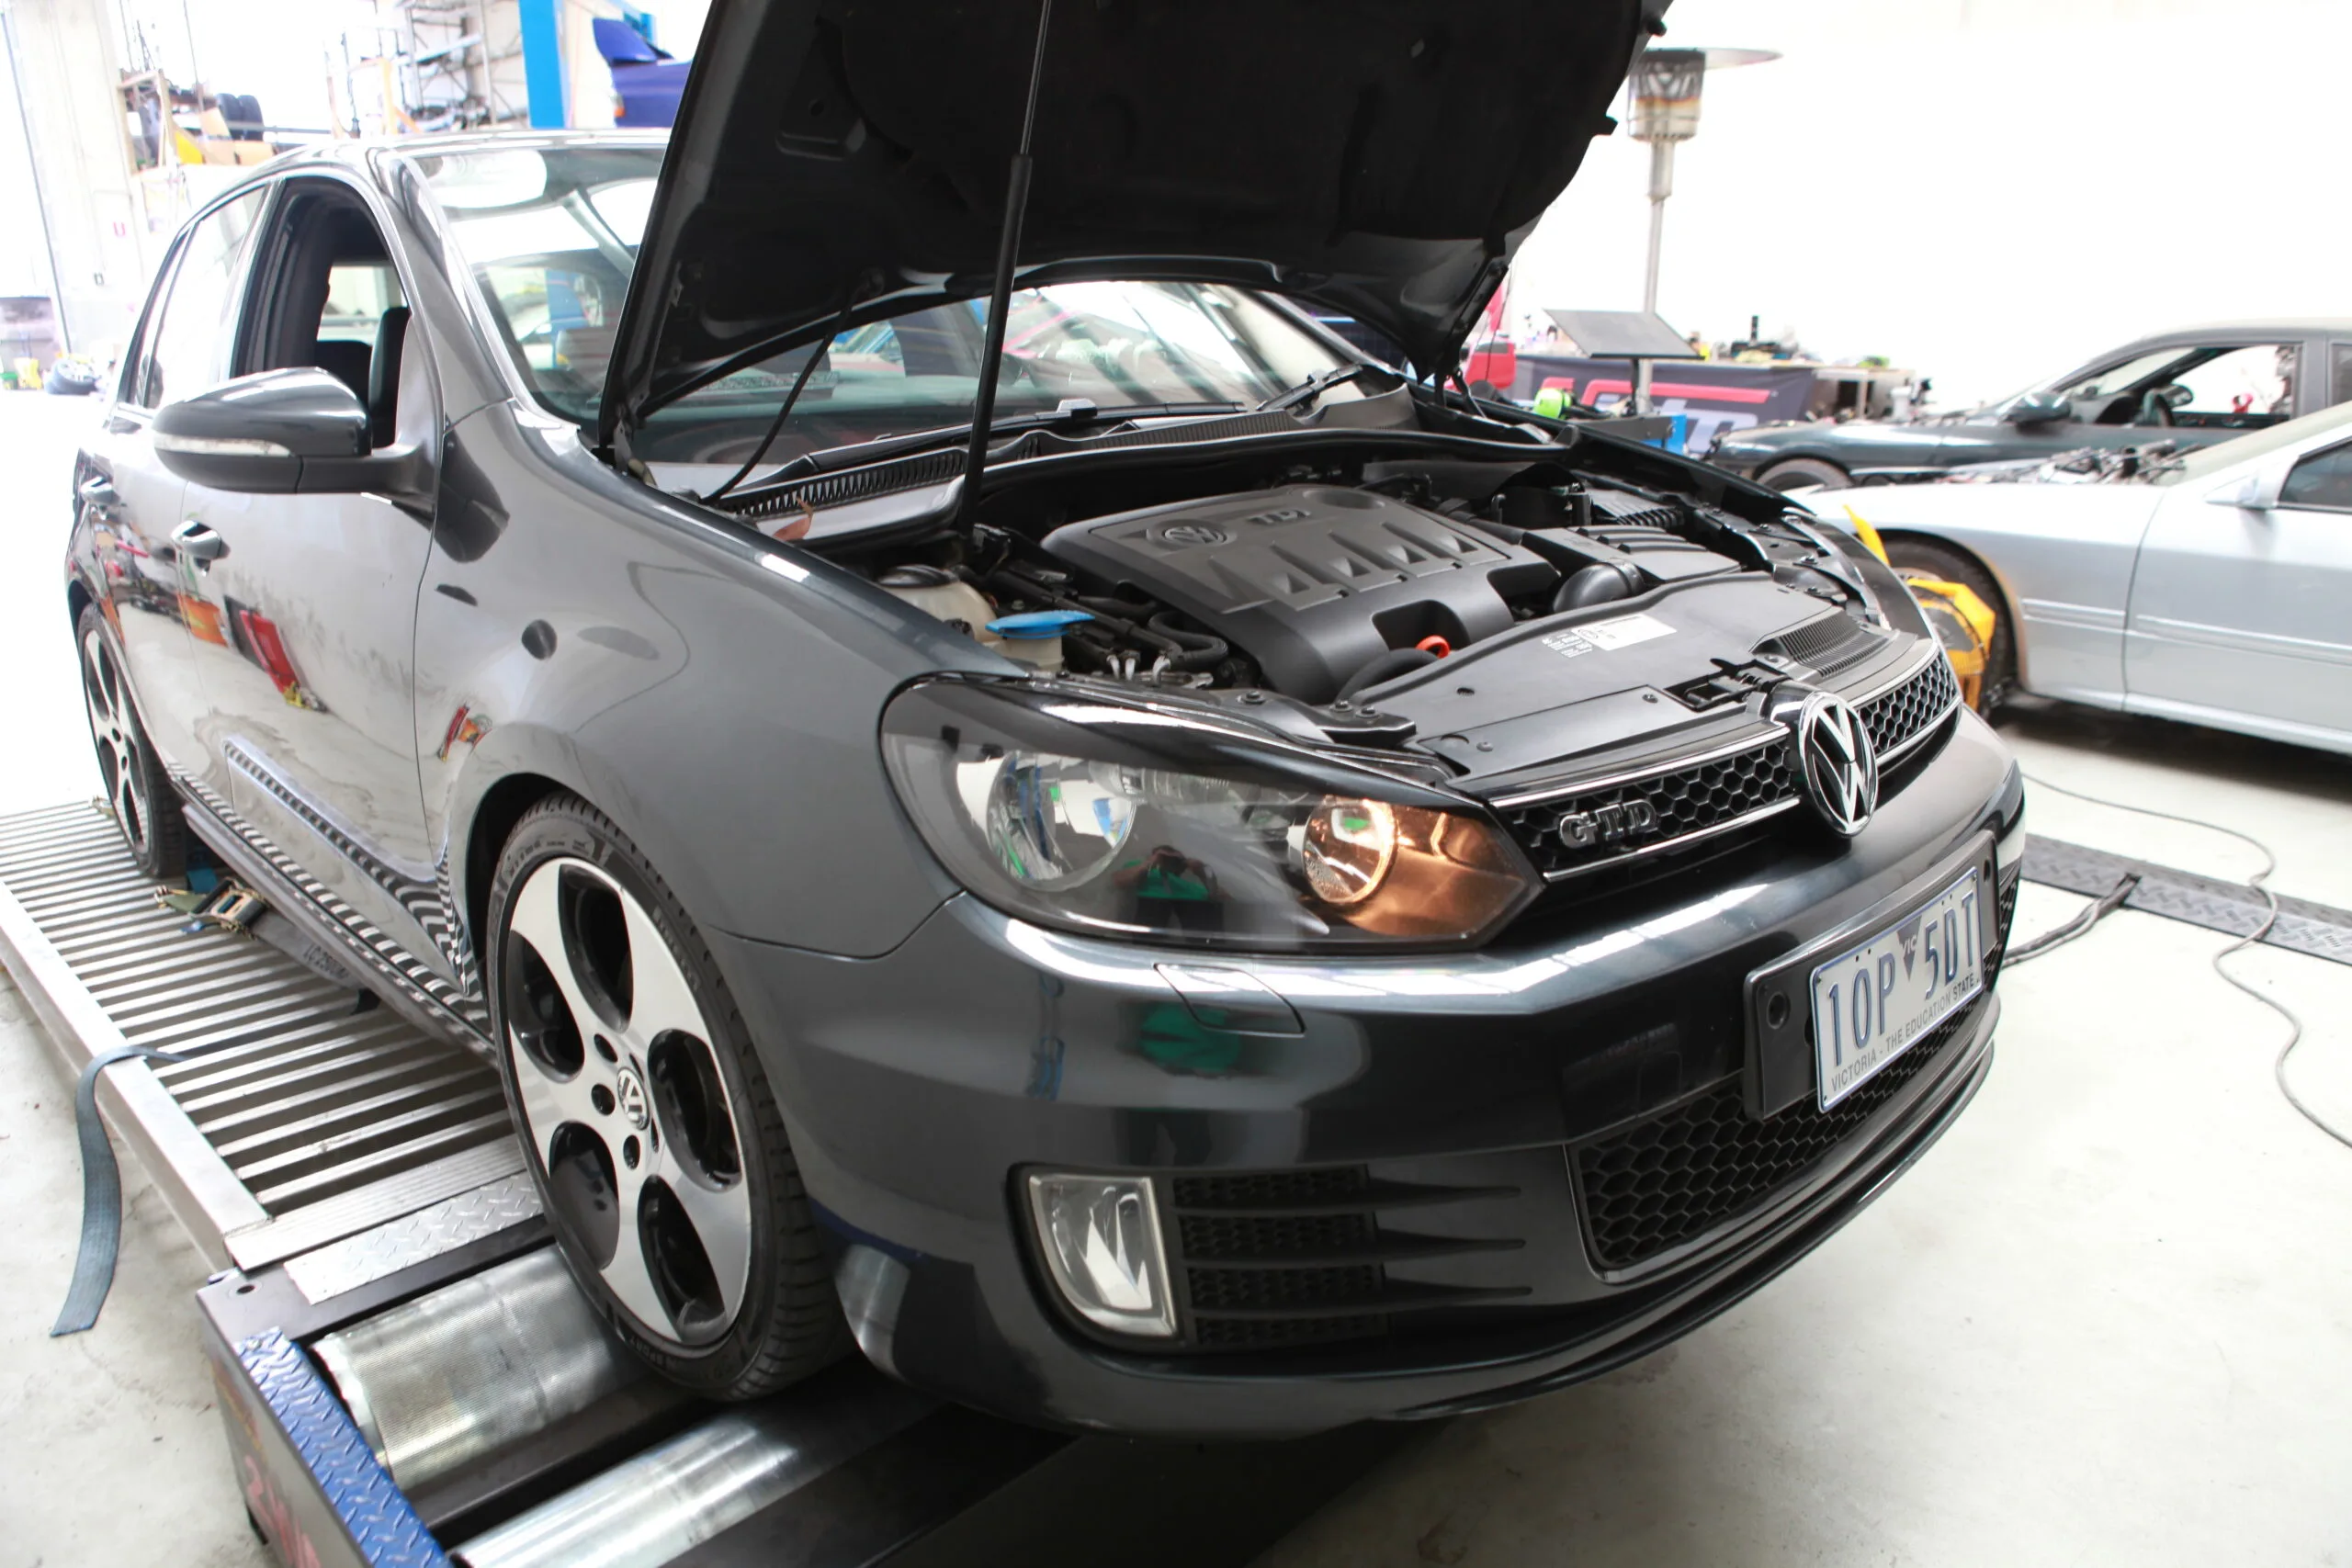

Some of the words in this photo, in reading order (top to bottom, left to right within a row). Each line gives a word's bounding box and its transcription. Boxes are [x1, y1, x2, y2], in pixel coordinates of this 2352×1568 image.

[1245, 507, 1313, 525] TDI
[1559, 798, 1657, 849] GTD
[1831, 1049, 1877, 1092] VICTORIA
[1885, 1031, 1903, 1052] THE
[1905, 991, 1951, 1037] EDUCATION
[1951, 972, 1974, 1001] STATE
